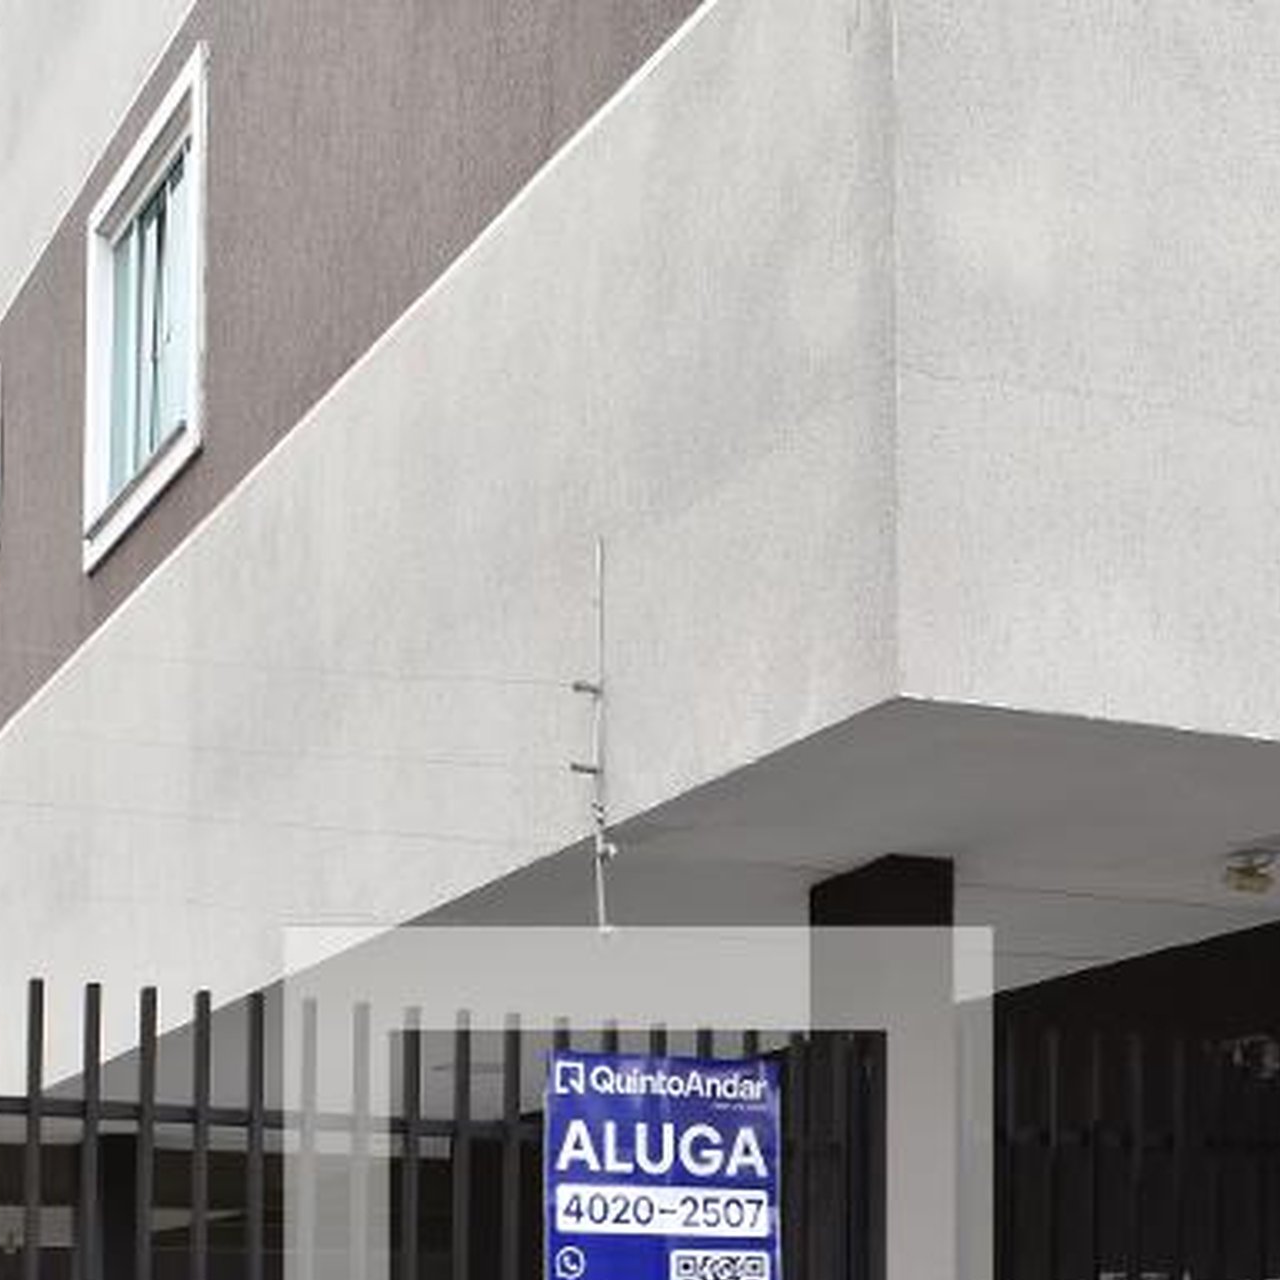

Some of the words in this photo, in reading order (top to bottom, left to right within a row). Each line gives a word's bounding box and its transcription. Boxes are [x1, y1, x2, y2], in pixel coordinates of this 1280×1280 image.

[590, 1065, 767, 1100] QuintoAndar
[556, 1119, 768, 1177] ALUGA
[562, 1193, 765, 1229] 4020-2507
